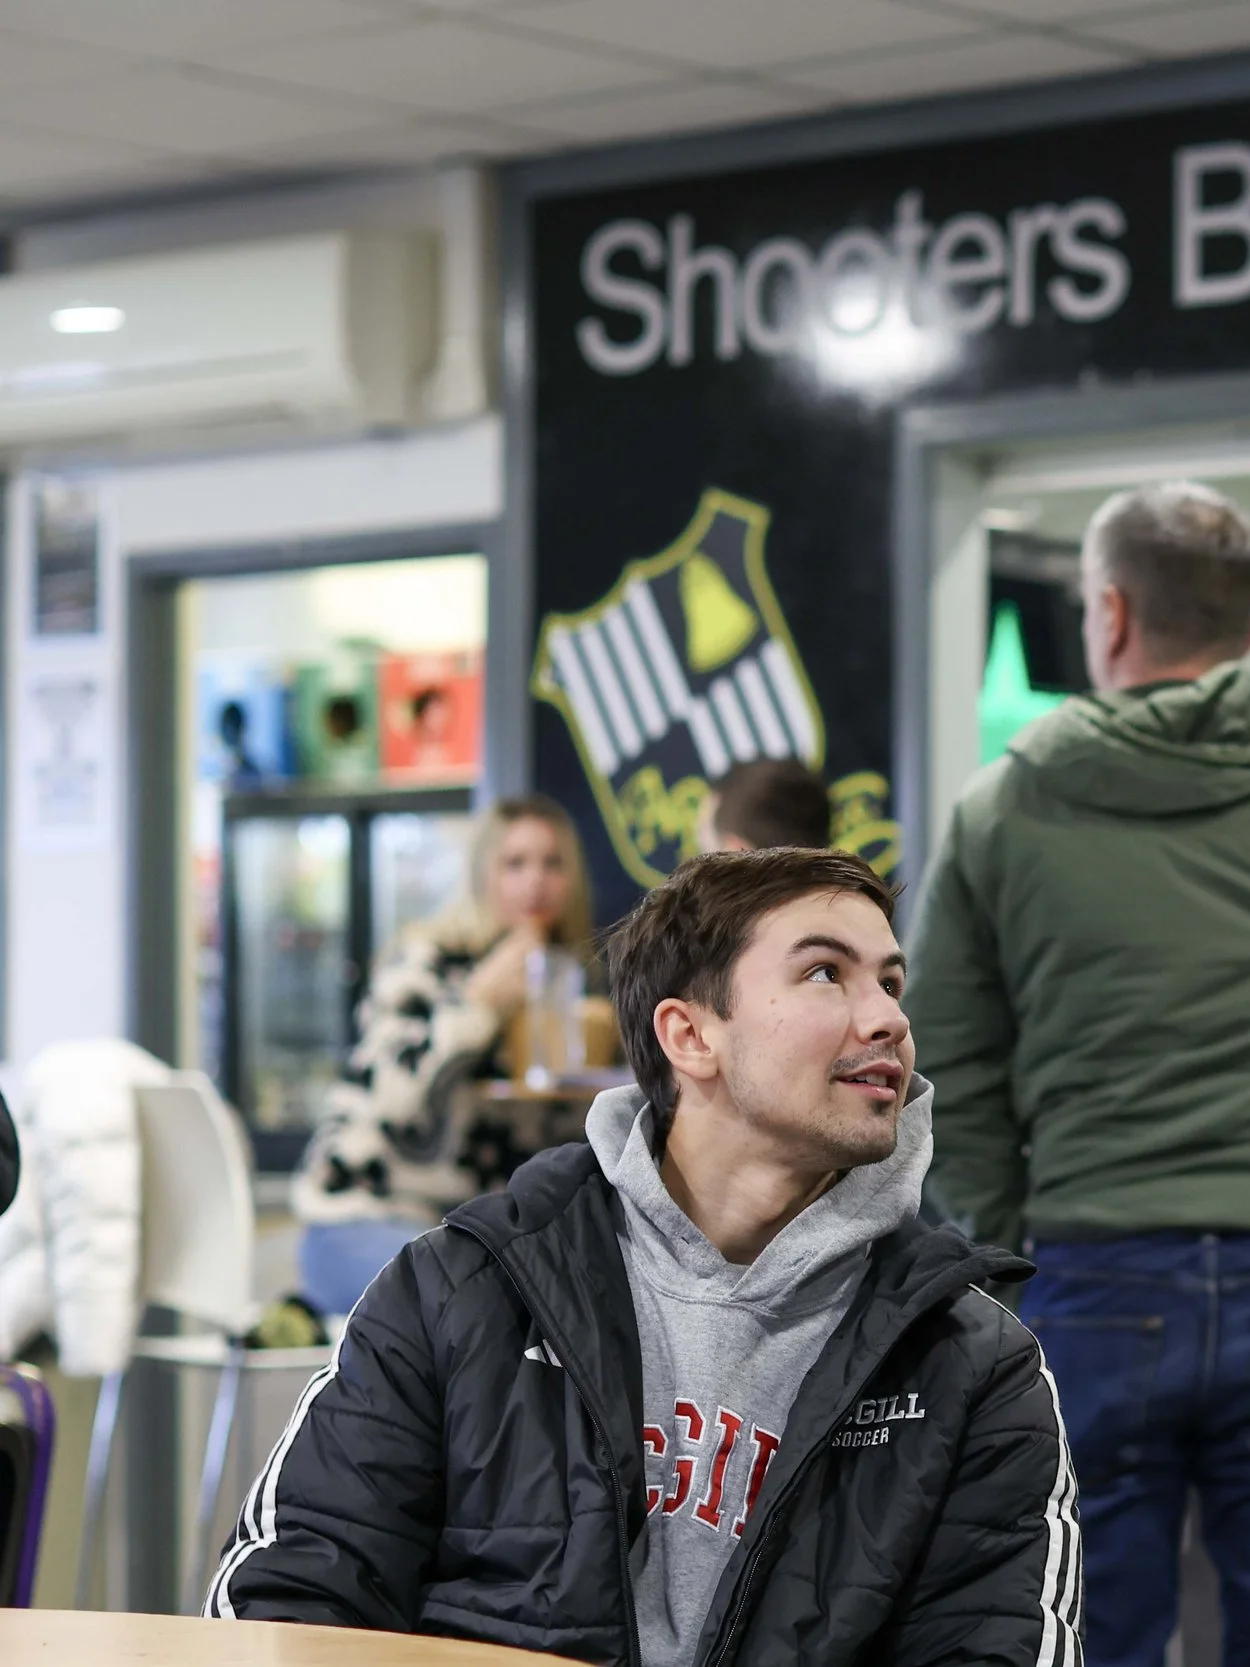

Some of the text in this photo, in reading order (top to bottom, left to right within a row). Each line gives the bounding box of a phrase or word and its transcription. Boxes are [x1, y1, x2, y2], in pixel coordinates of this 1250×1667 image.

[576, 189, 1131, 376] Shooters
[845, 1393, 925, 1425] GILL
[832, 1427, 889, 1447] SOCCER
